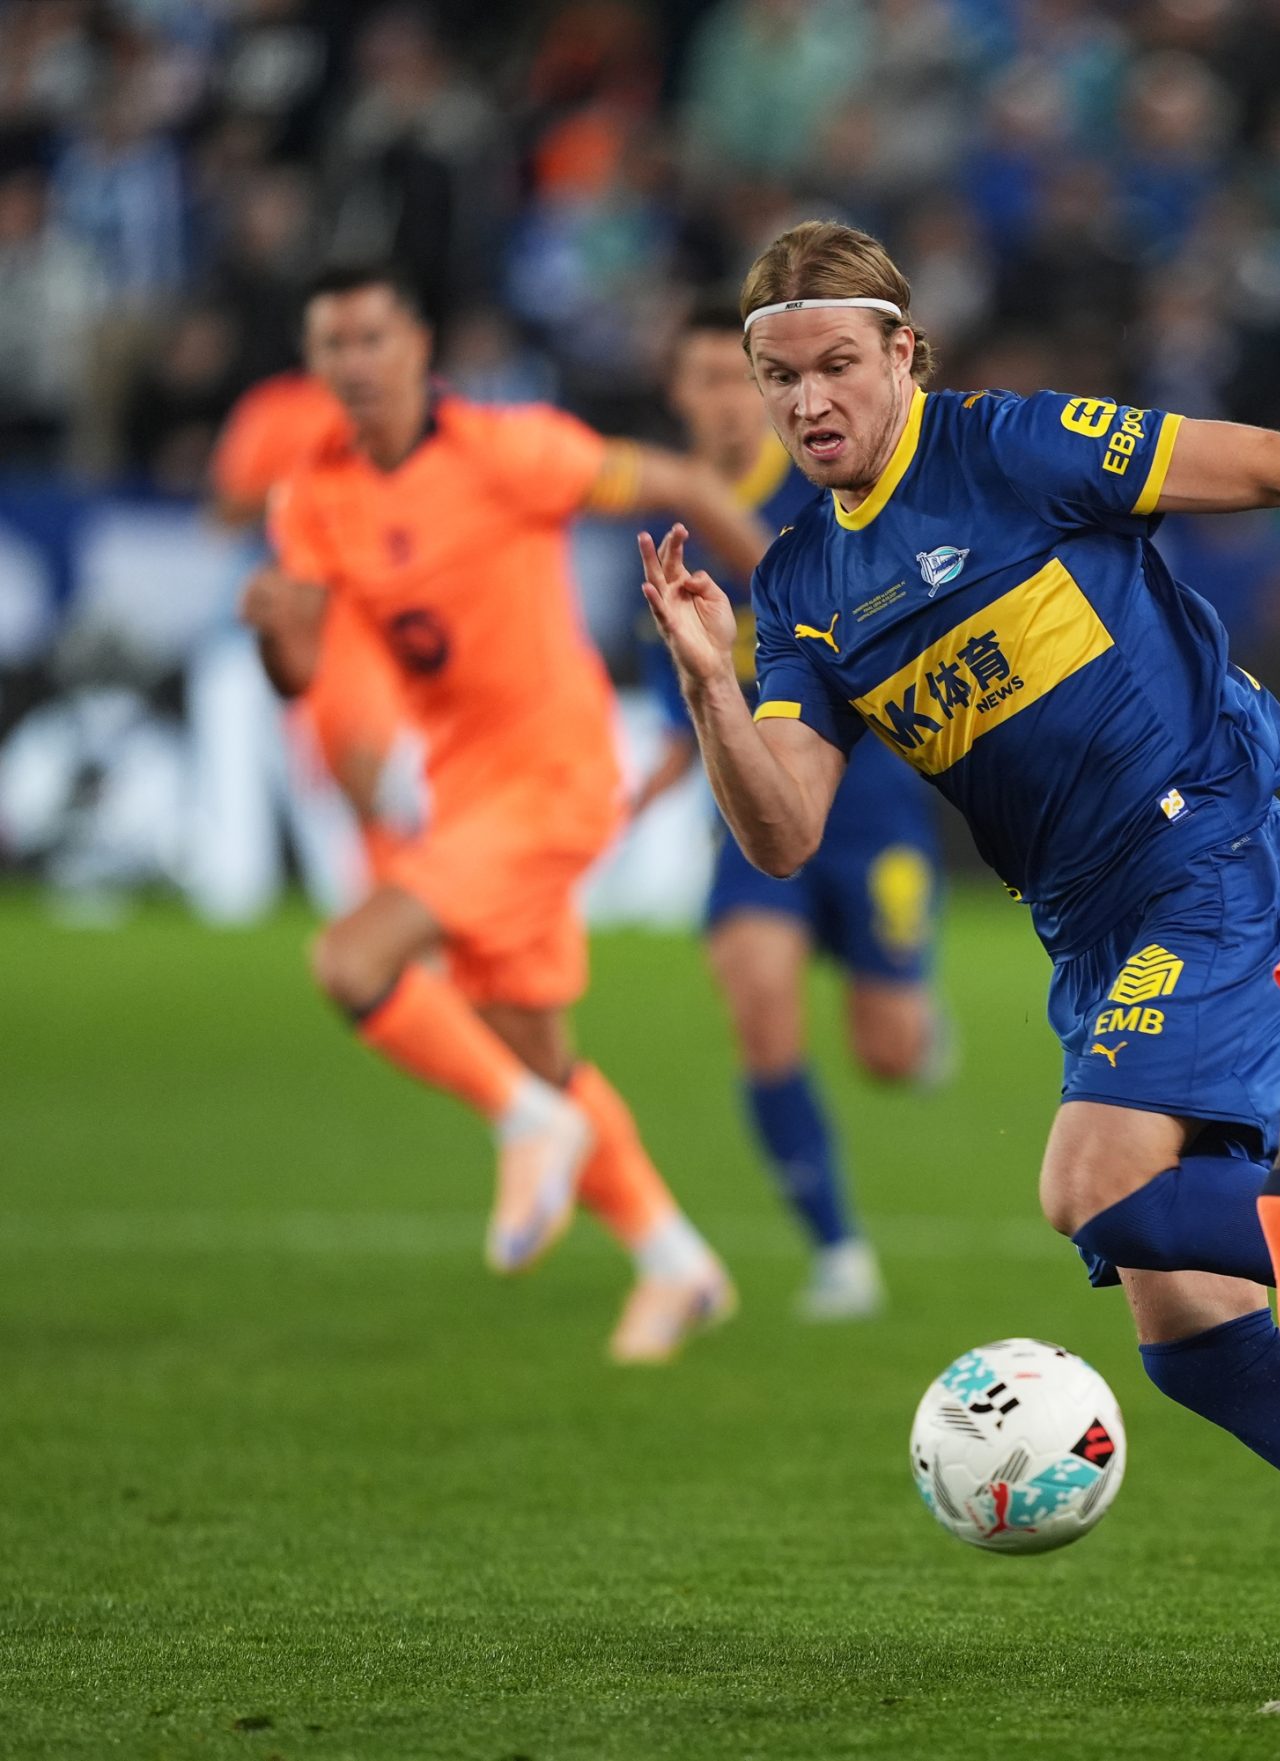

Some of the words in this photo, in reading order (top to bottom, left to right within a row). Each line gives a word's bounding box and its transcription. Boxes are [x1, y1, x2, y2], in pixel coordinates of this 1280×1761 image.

[1101, 406, 1152, 477] EBpa
[975, 674, 1025, 715] NEWS
[1093, 1006, 1165, 1036] EMB
